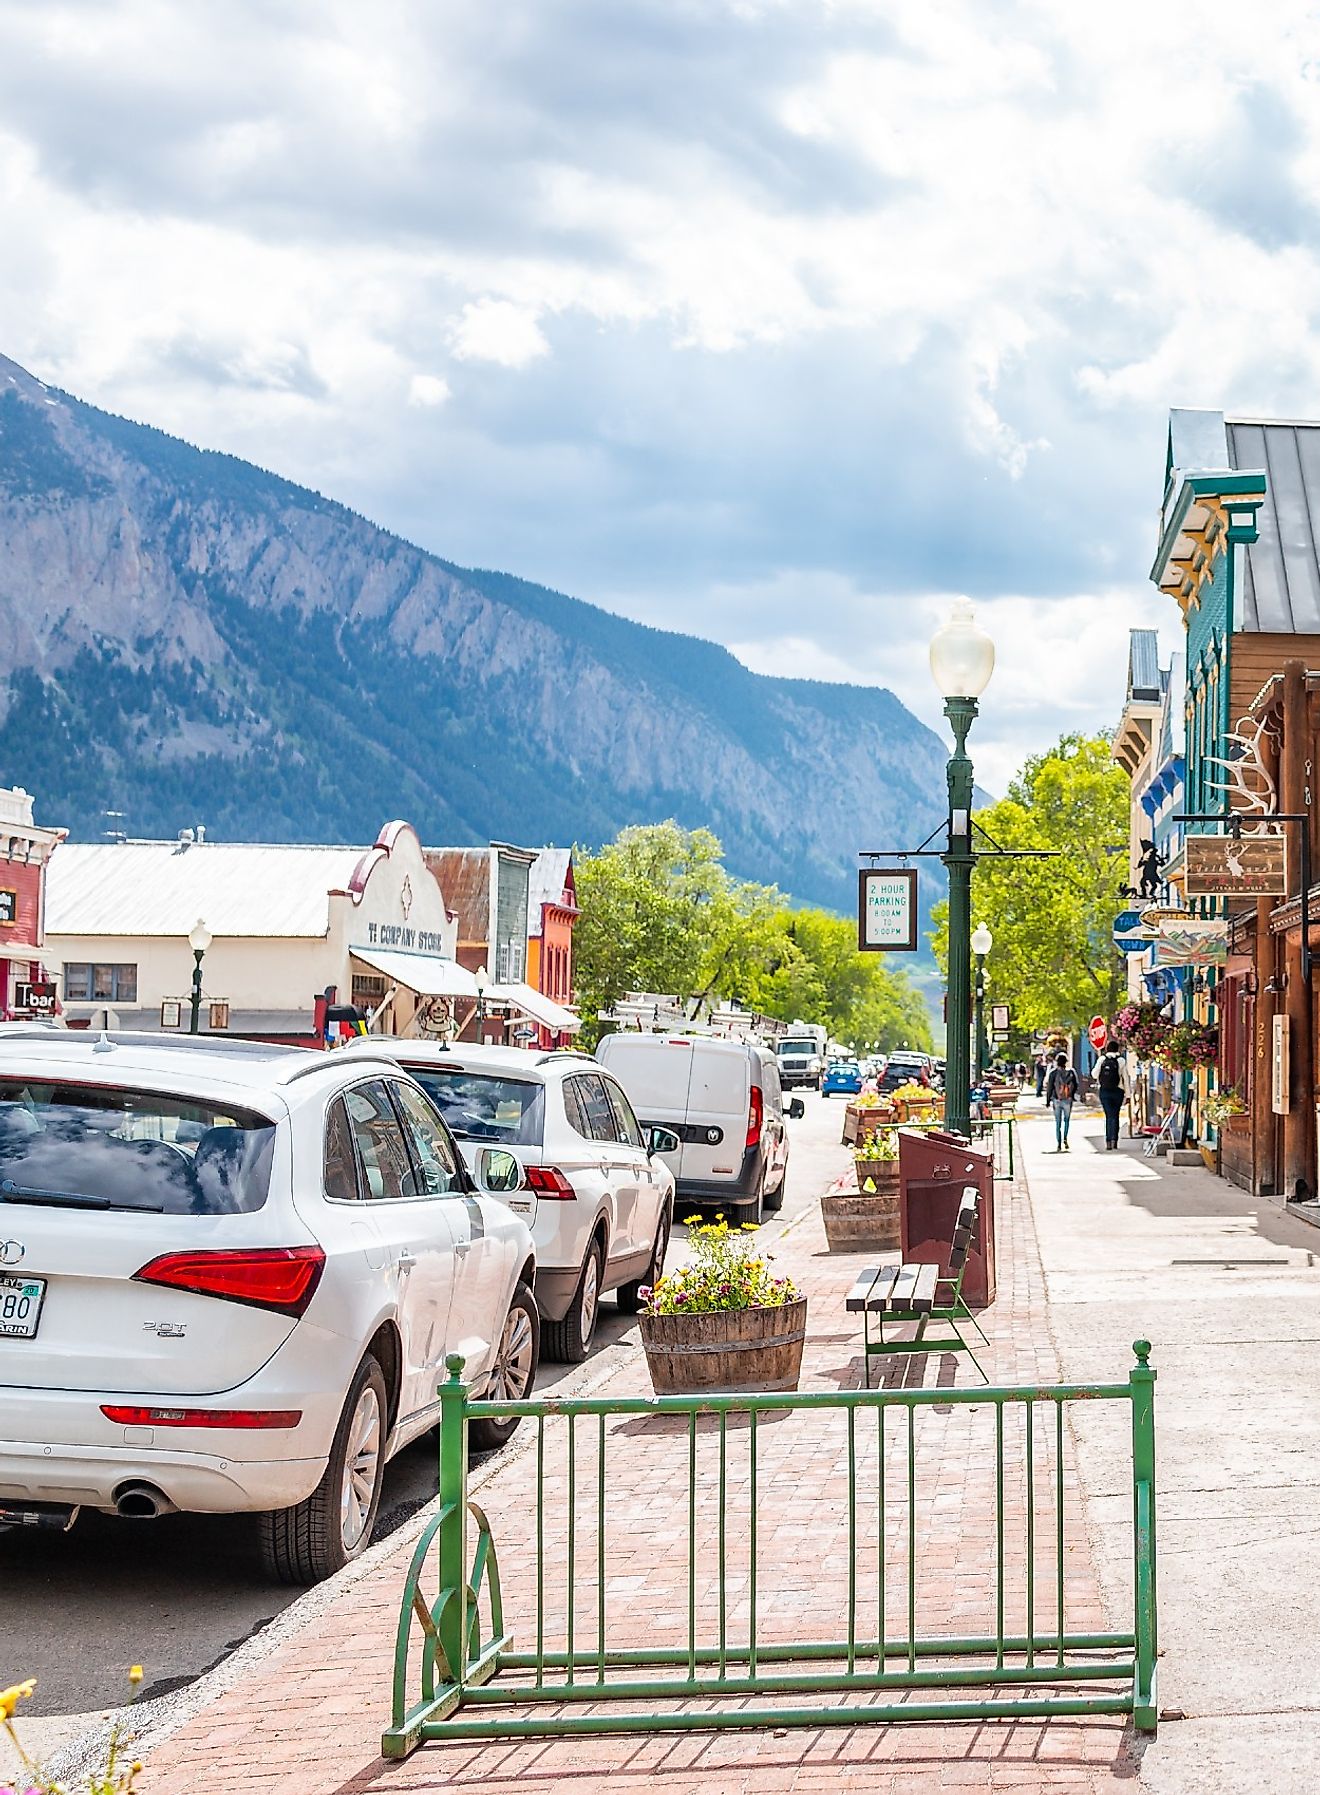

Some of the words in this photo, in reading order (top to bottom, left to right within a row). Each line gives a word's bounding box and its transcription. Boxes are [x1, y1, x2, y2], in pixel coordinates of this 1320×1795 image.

[870, 885, 876, 894] 2
[881, 885, 904, 894] HOUR
[869, 897, 906, 906] PARKING
[380, 925, 417, 948] COMPANY
[418, 930, 442, 952] STORE
[1091, 1024, 1107, 1041] STOP
